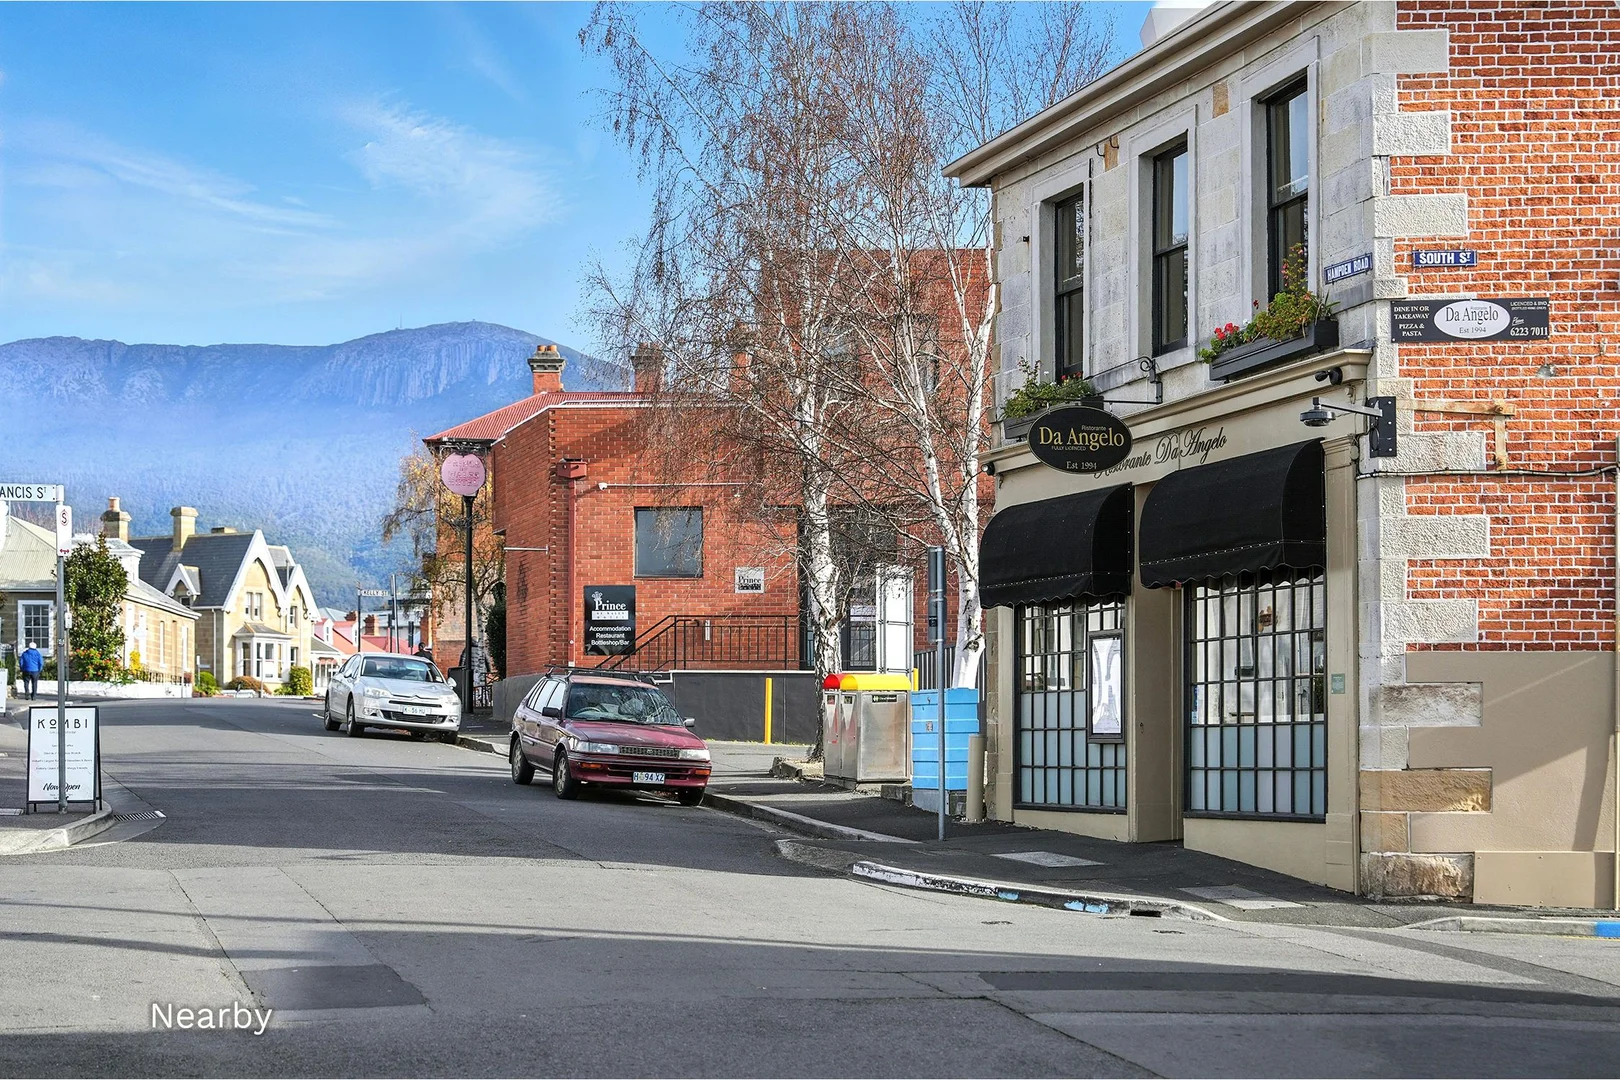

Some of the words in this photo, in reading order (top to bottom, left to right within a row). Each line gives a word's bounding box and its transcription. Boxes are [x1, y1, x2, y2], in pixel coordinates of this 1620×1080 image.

[1419, 252, 1455, 264] SOUTH
[1326, 262, 1352, 281] HAMPDEN
[1353, 258, 1369, 273] ROAD
[1446, 307, 1460, 322] Da
[1462, 306, 1499, 325] Angelo
[1510, 327, 1529, 336] 6223
[1530, 327, 1548, 336] 7011
[1039, 426, 1063, 445] Da
[1067, 427, 1125, 451] Angelo
[1154, 434, 1179, 464] Da
[1180, 427, 1227, 464] Angelo
[1066, 461, 1078, 469] Est
[595, 600, 626, 610] Prince
[633, 772, 639, 781] H
[644, 773, 653, 781] 94
[656, 774, 664, 782] XZ
